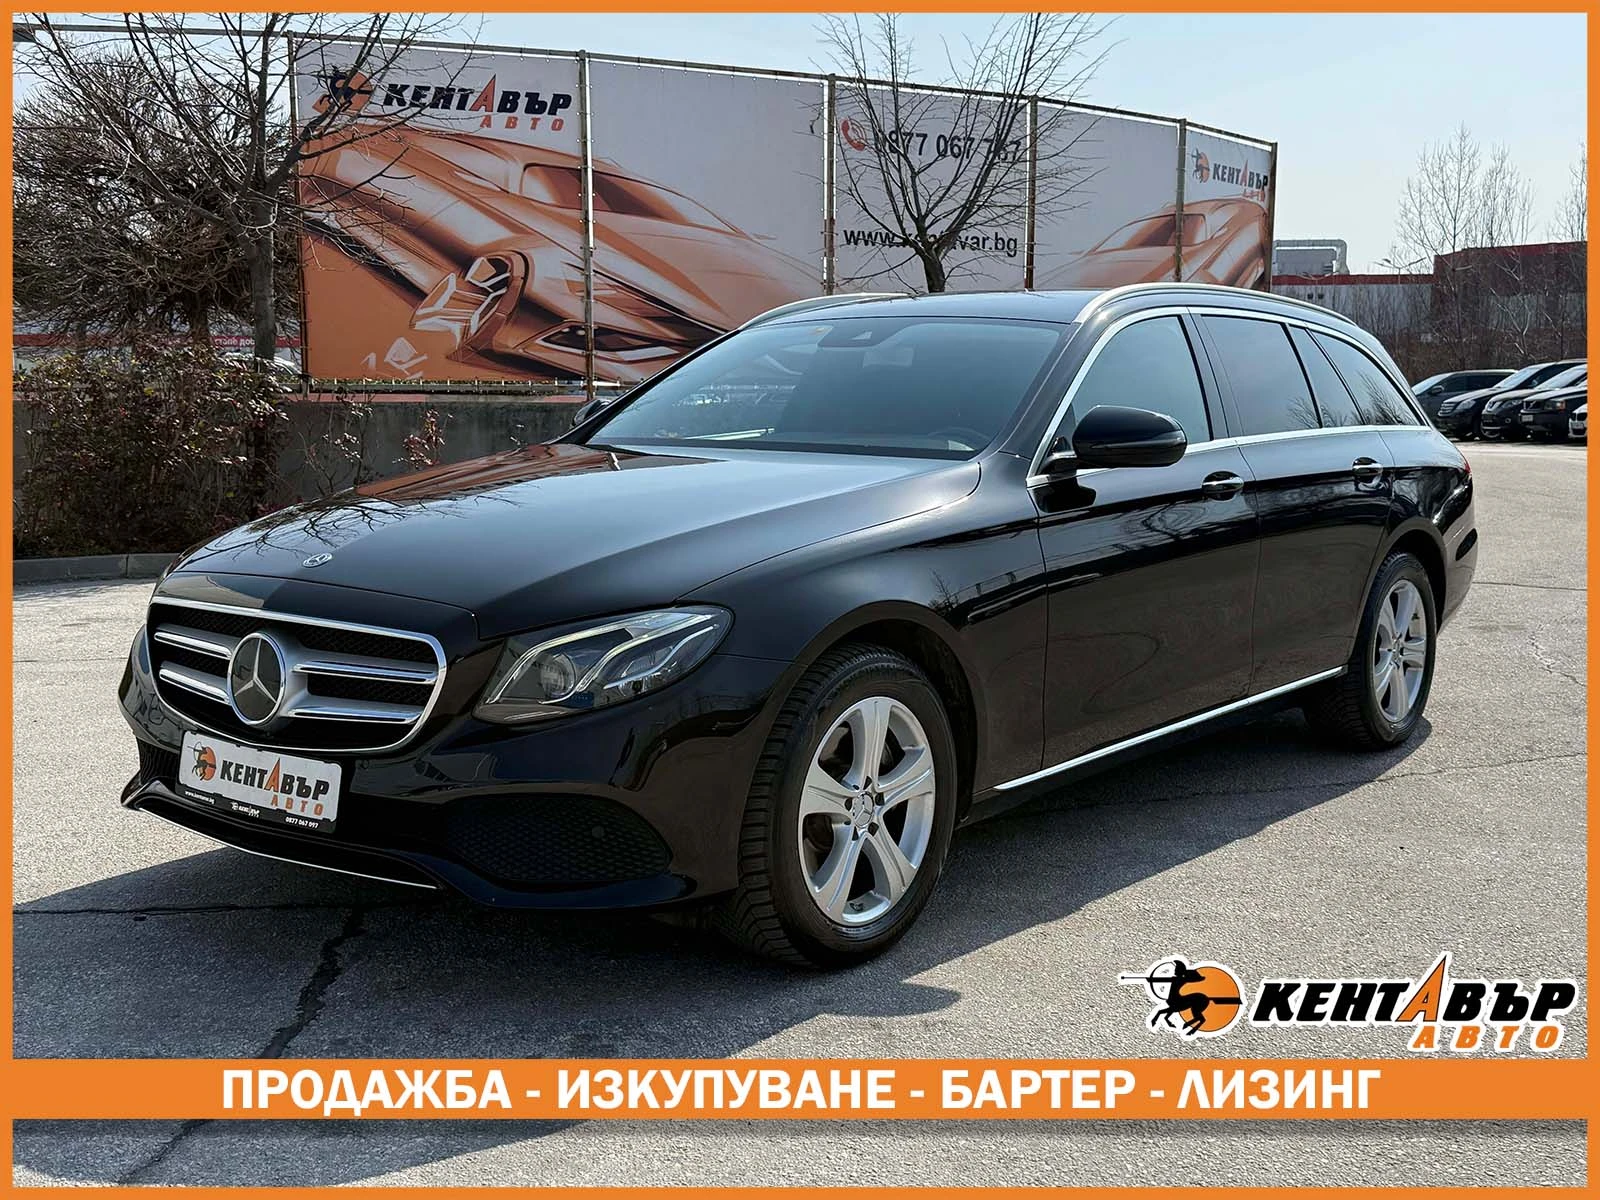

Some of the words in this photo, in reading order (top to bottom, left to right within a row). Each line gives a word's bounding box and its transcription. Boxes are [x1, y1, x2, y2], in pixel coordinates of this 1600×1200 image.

[383, 74, 572, 115] КЕНТАВЪР
[480, 115, 564, 131] АВТО
[936, 134, 975, 159] 067
[1213, 159, 1268, 191] КЕНТАВЪР
[220, 758, 330, 800] КЕНТАВЪР
[271, 794, 324, 816] АВТО
